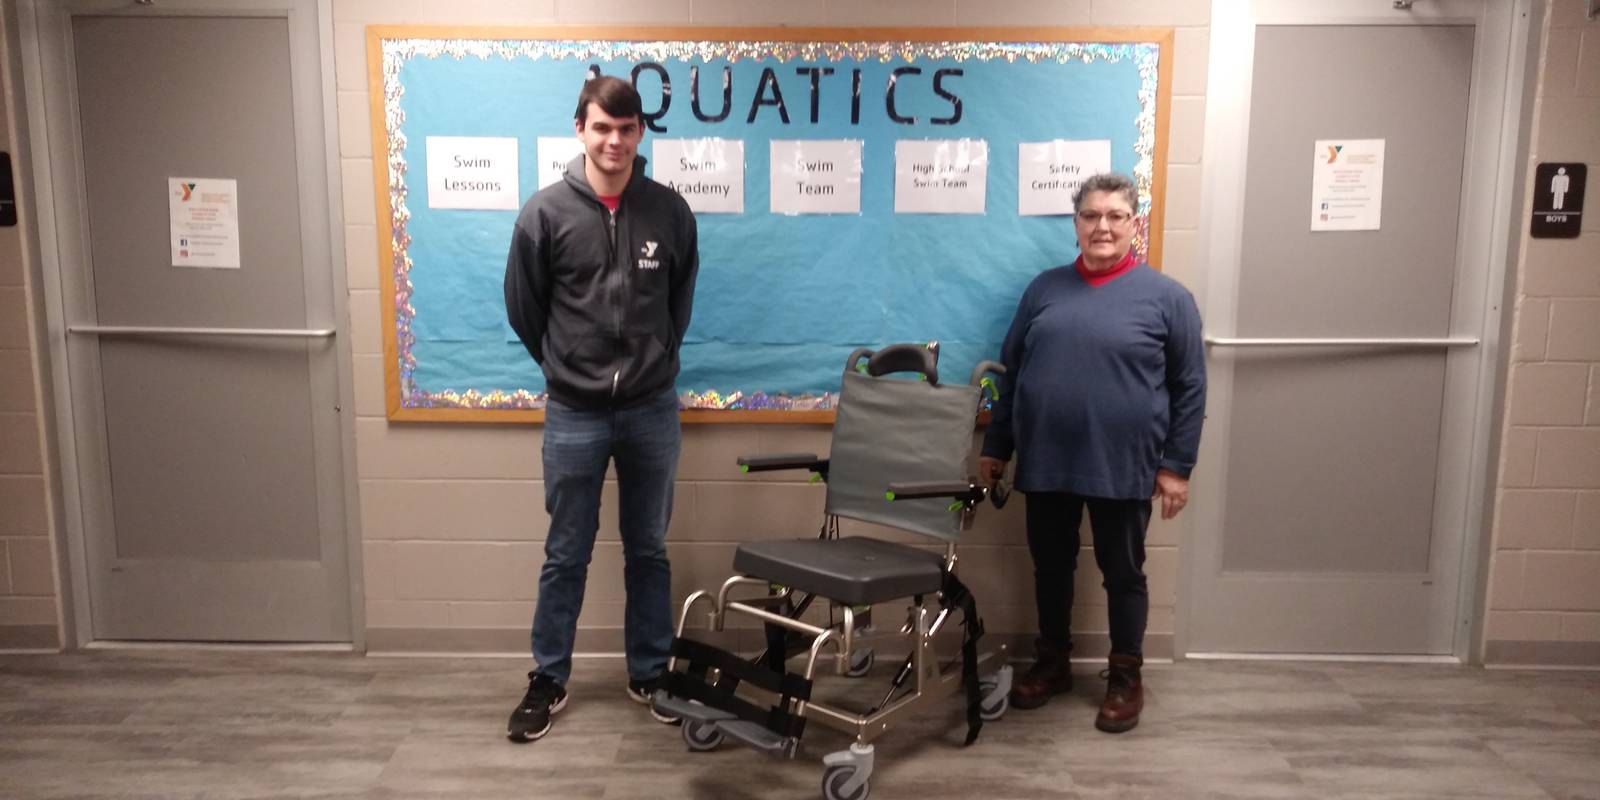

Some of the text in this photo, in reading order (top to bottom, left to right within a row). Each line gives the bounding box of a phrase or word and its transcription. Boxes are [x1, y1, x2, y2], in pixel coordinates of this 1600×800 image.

[454, 155, 491, 168] Swim
[680, 157, 716, 171] Swim
[797, 160, 833, 172] Swim
[912, 164, 935, 174] High
[1049, 164, 1081, 174] Safety
[444, 178, 501, 191] Lessons
[796, 181, 834, 195] Team
[914, 178, 968, 188] Swim Team
[1031, 181, 1081, 190] Certificati
[669, 181, 730, 197] Academy
[1546, 215, 1567, 223] BOYS
[638, 259, 660, 269] STAFF
